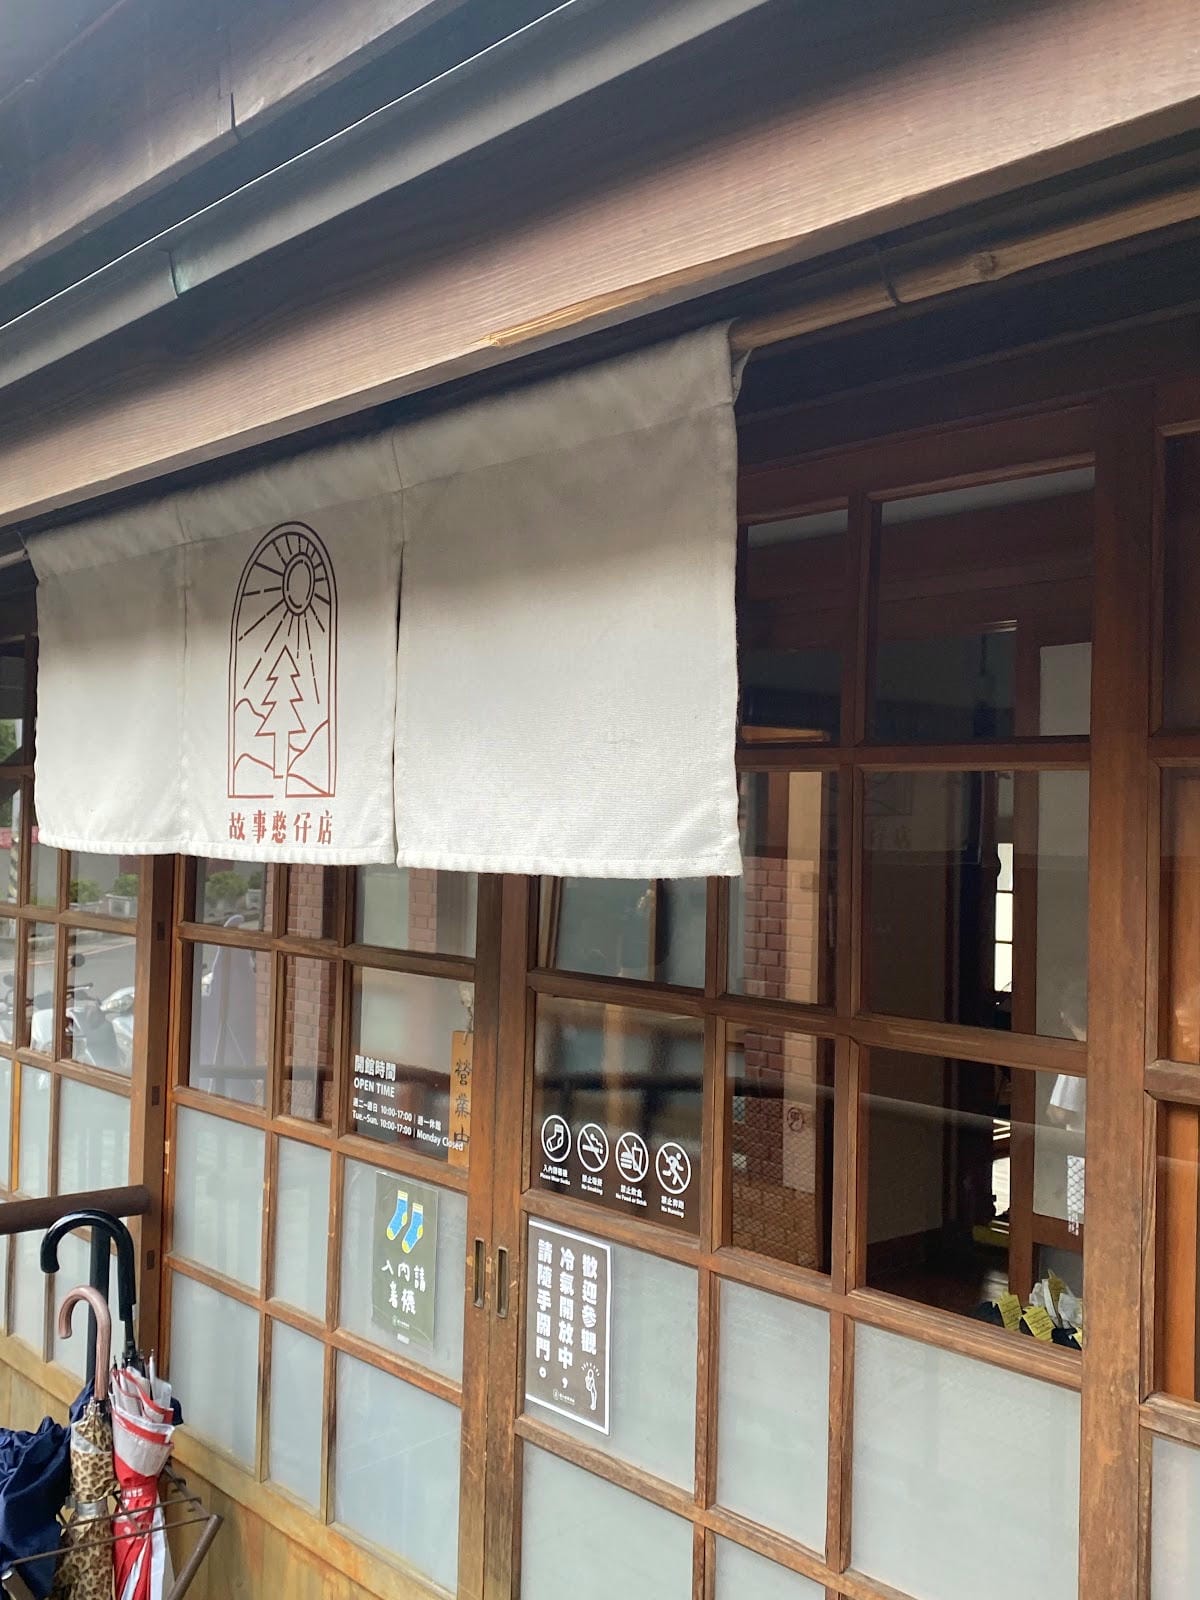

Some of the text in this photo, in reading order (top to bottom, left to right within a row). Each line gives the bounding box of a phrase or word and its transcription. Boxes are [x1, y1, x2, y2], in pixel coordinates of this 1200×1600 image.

[354, 1054, 396, 1082] 開館時間
[353, 1077, 396, 1098] OPEN TIME
[454, 1058, 472, 1145] 營業中
[380, 1105, 413, 1122] 10:00-17:00
[380, 1119, 412, 1135] 10:00-17:00
[416, 1129, 441, 1147] Monday
[442, 1136, 464, 1152] Closed
[581, 1253, 598, 1356] 歡迎參觀
